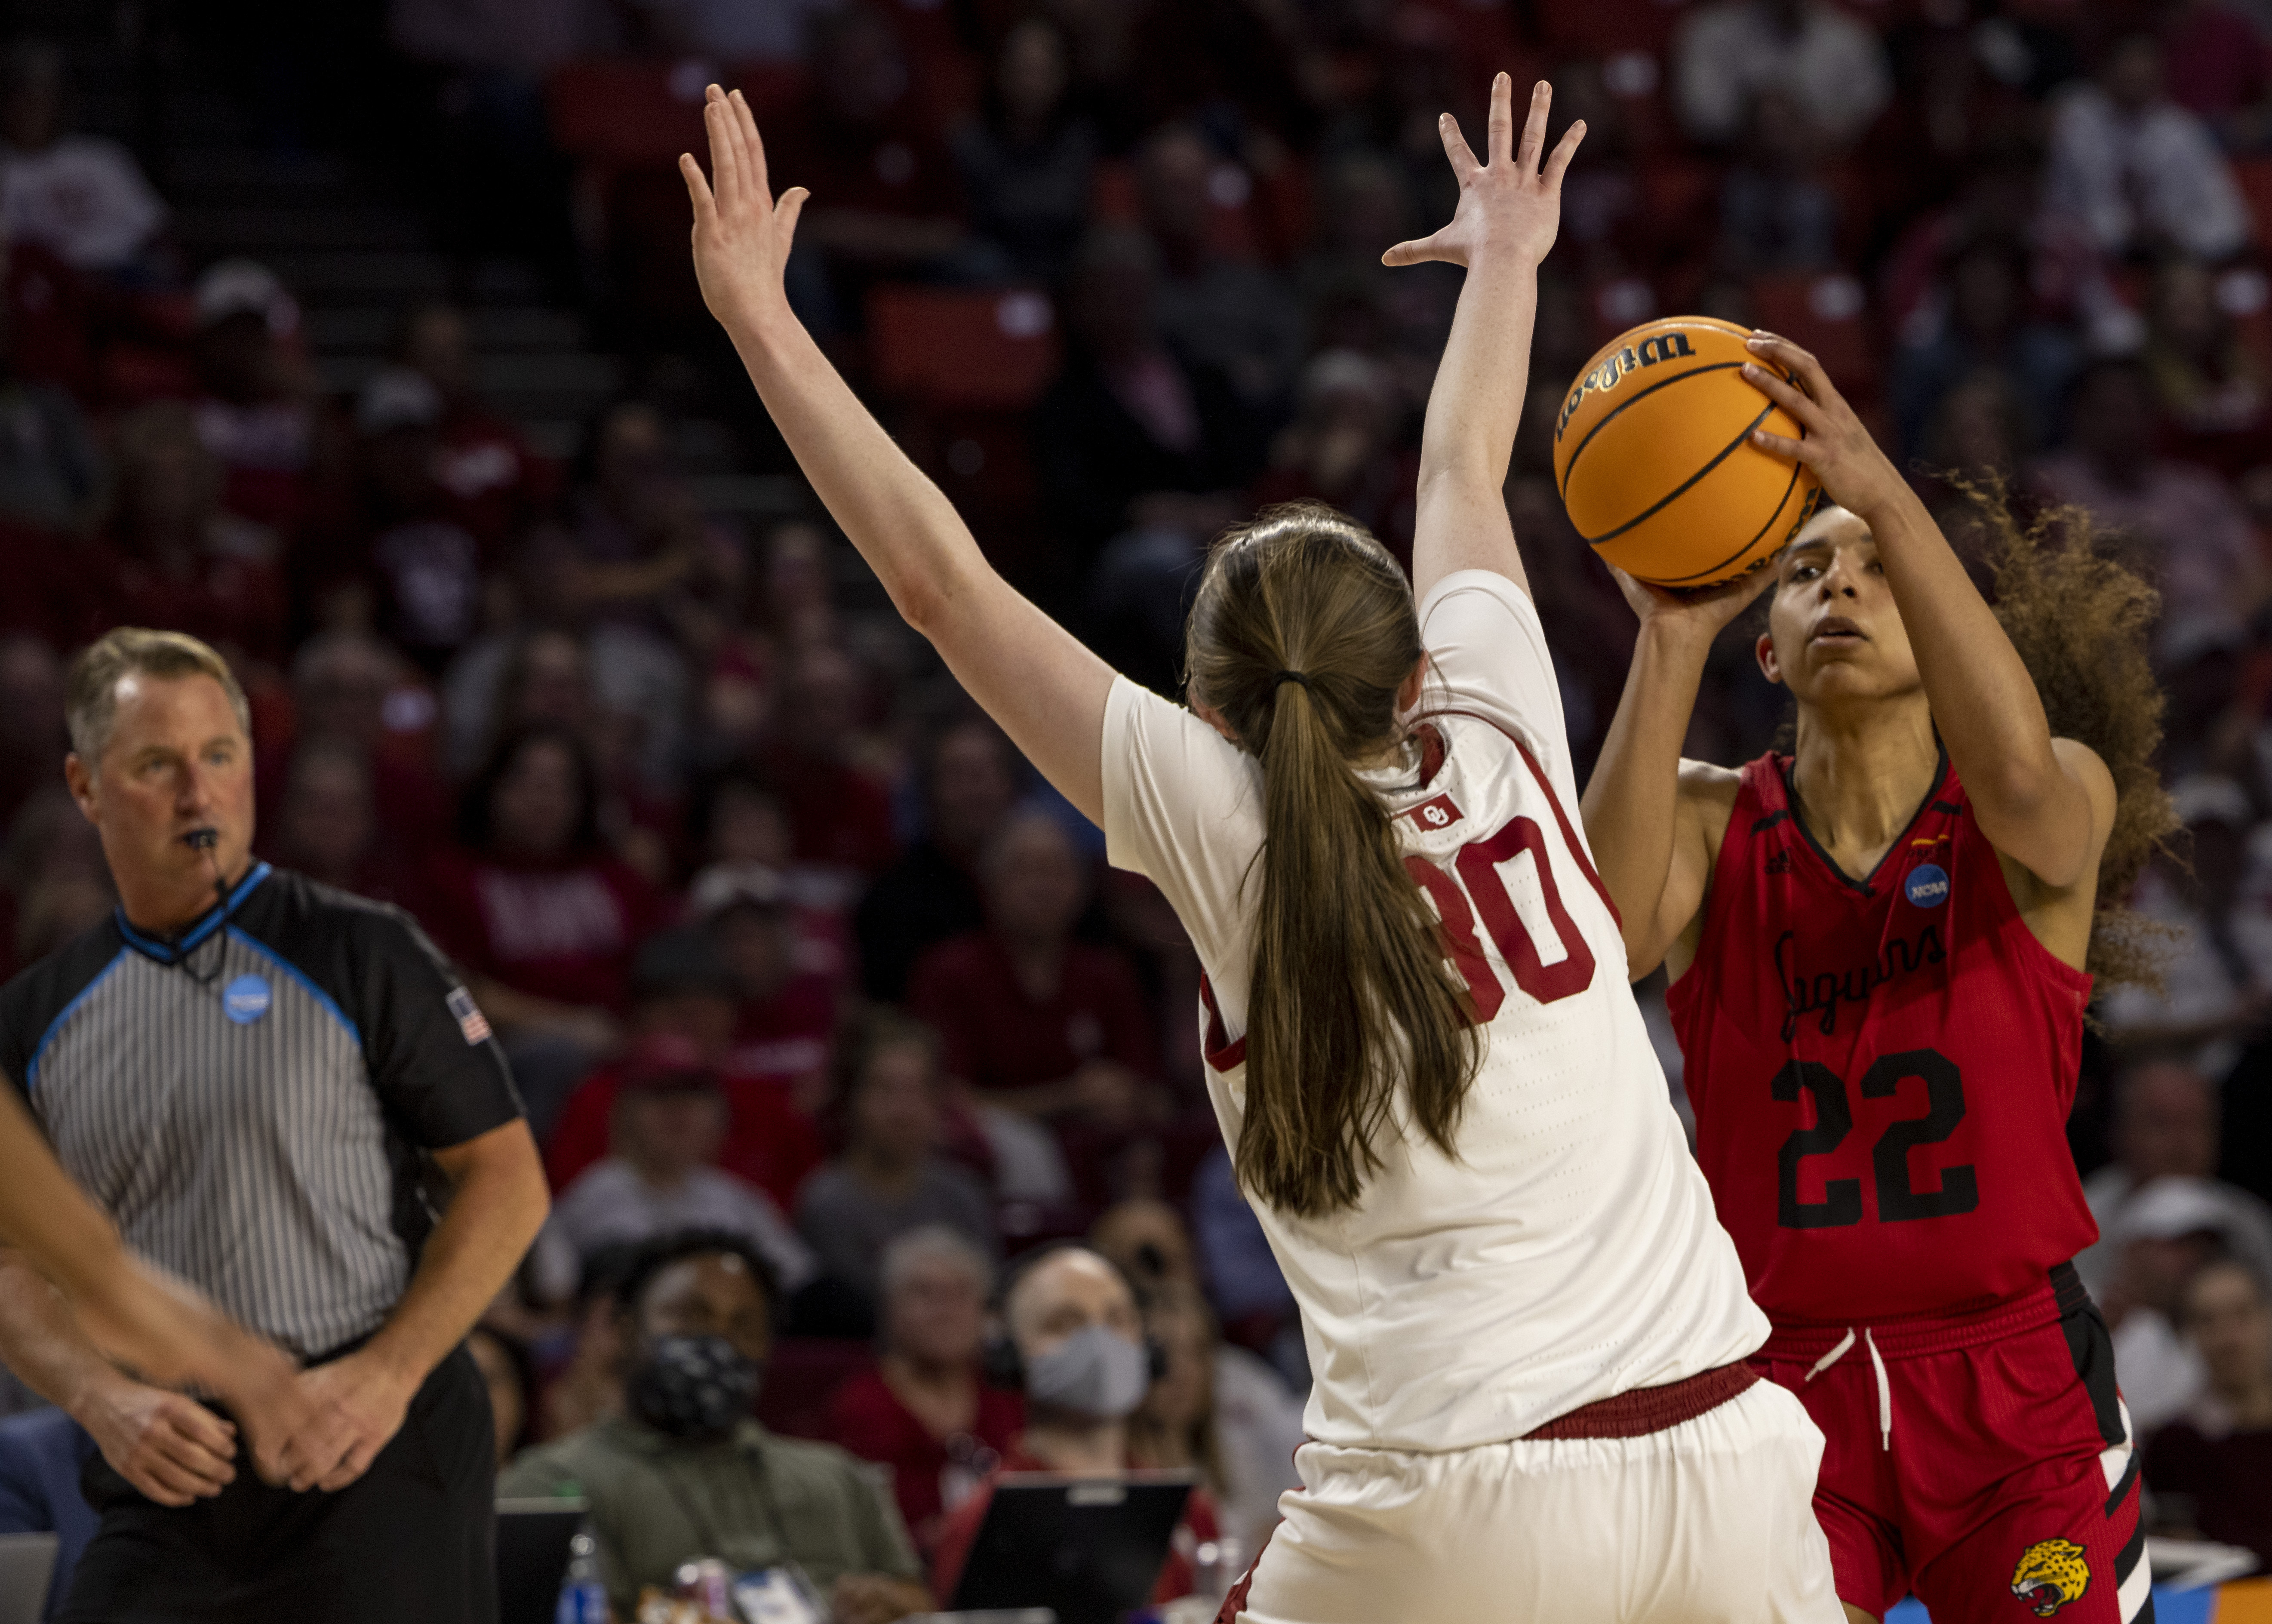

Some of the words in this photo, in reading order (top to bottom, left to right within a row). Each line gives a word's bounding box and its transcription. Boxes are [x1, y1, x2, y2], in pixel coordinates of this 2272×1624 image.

[1557, 331, 1697, 443] Wilson
[1423, 805, 1449, 825] OU
[1911, 880, 1948, 899] NCAA
[1774, 924, 1946, 1044] Jagurs
[1770, 1048, 1979, 1229] 22
